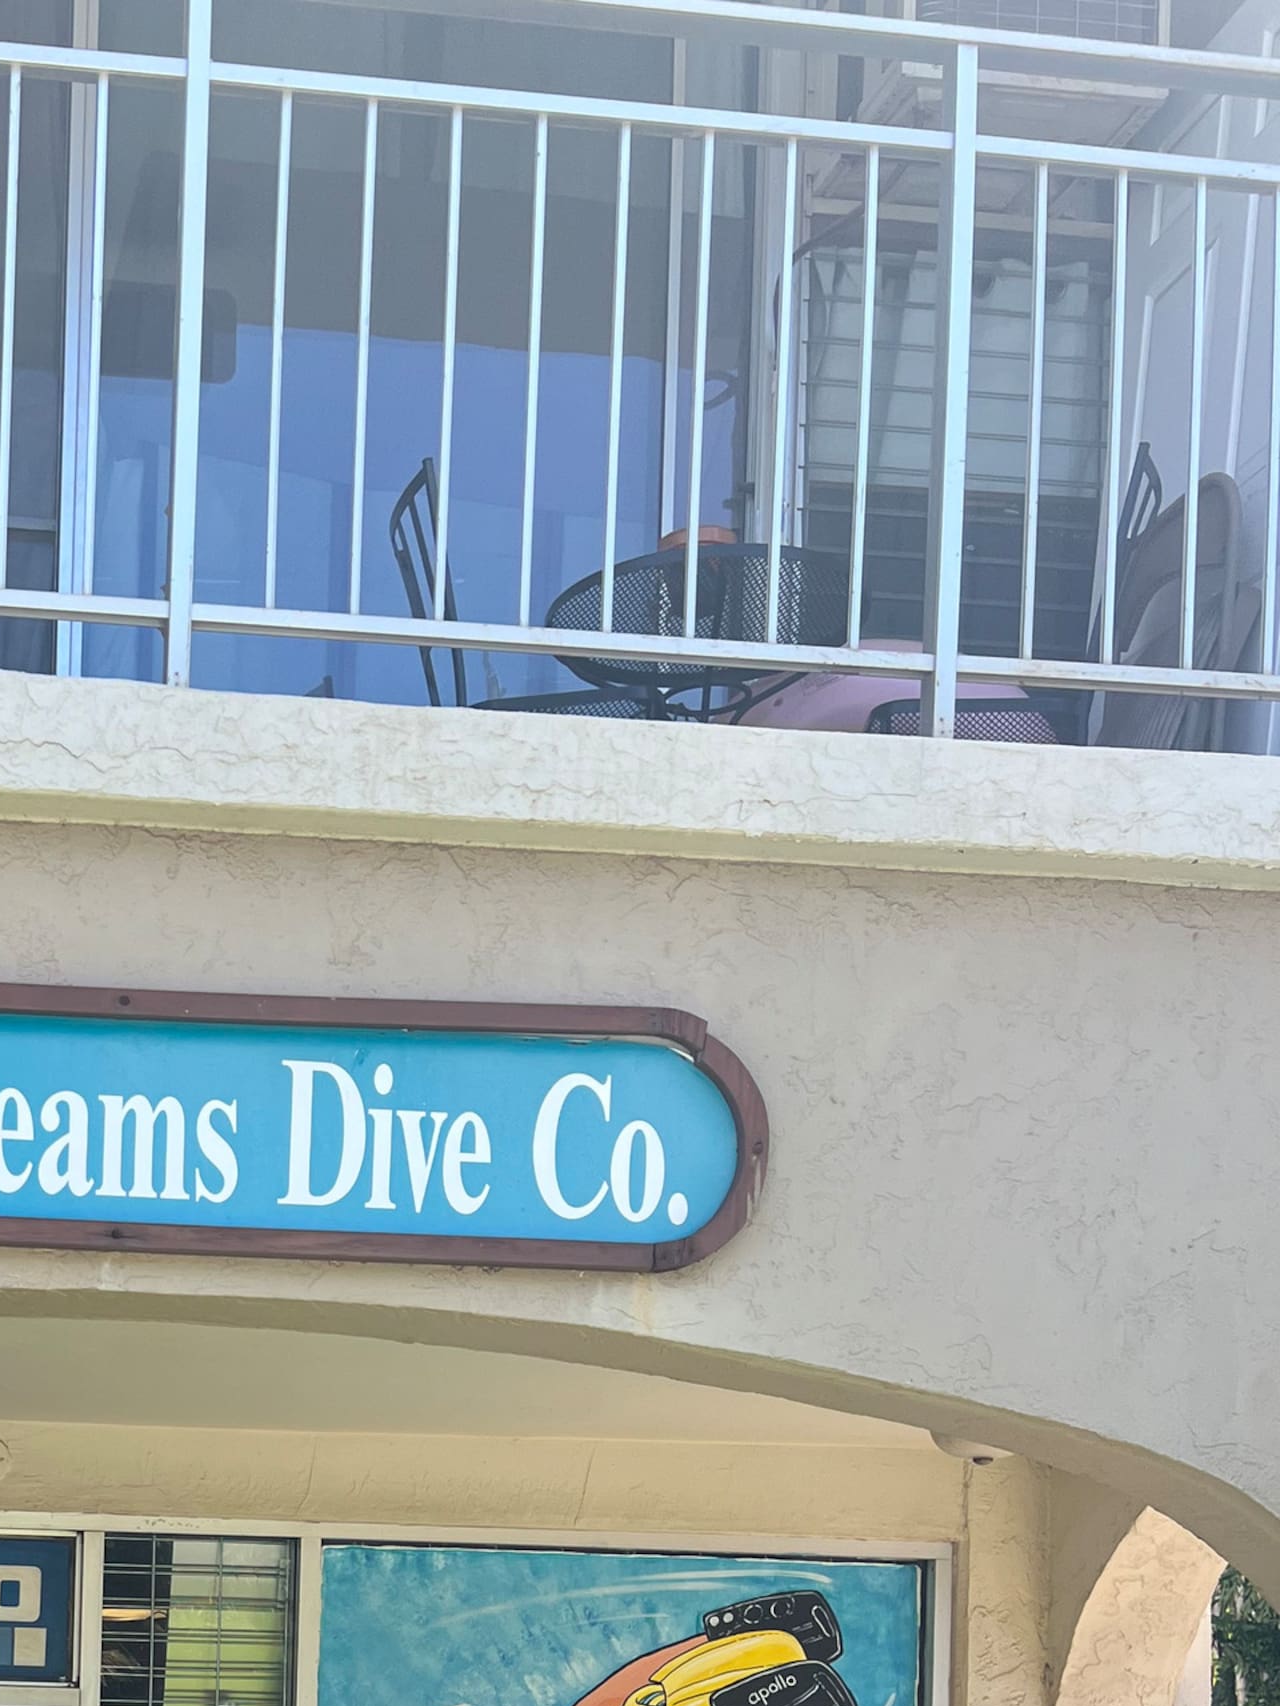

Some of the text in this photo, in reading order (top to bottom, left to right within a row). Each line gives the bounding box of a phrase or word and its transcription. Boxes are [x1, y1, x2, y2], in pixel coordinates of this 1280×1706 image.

[277, 1058, 492, 1216] Dive
[532, 1072, 690, 1225] Co.
[748, 1674, 797, 1706] apollo
